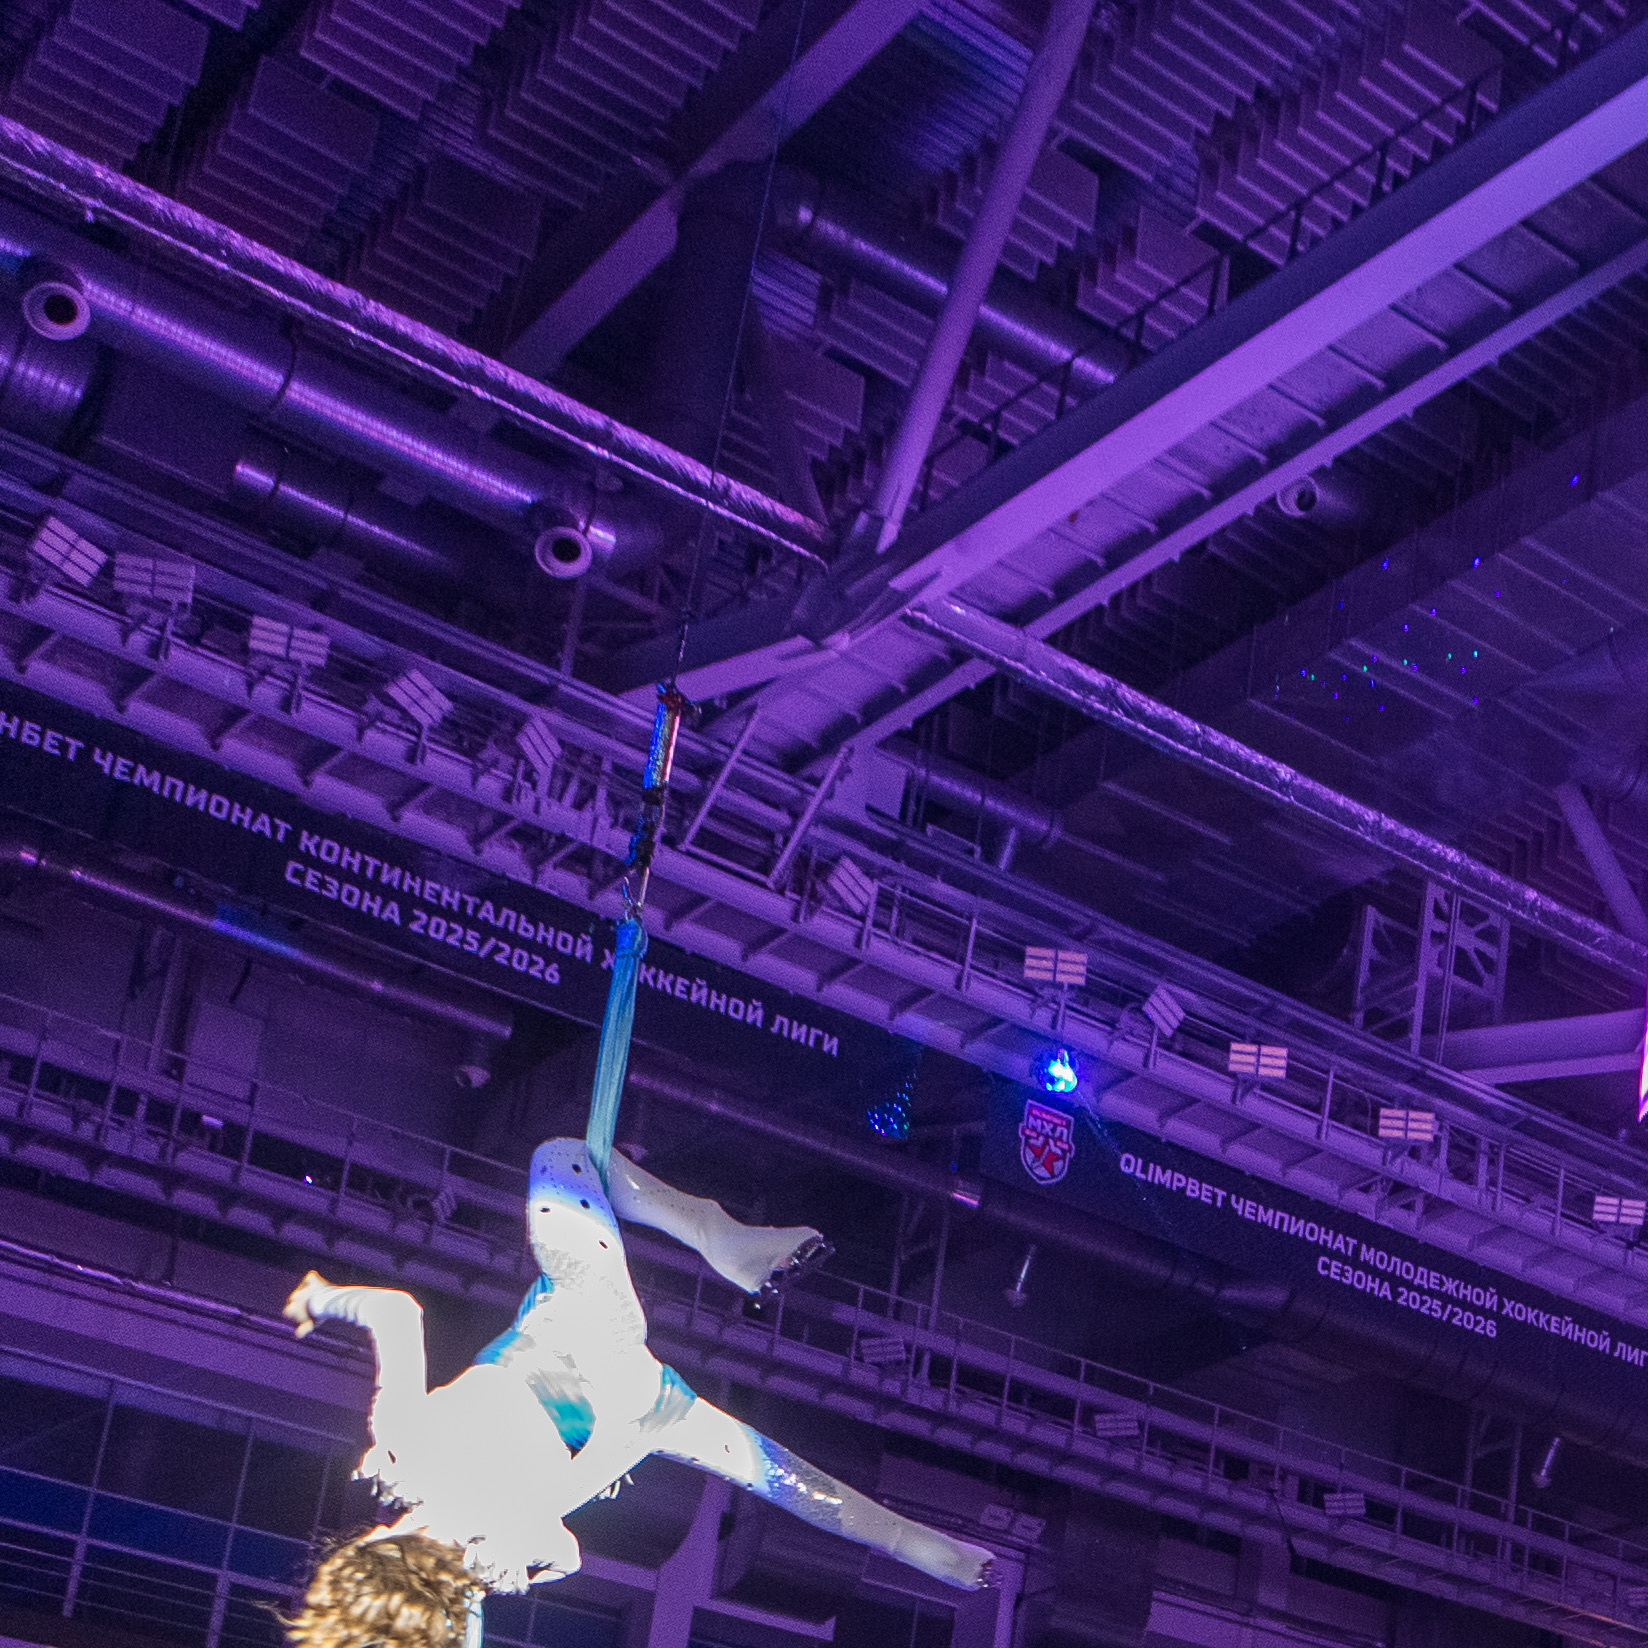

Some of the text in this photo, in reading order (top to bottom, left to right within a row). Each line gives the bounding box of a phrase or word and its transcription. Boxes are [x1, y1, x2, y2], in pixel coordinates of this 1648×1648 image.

[93, 745, 292, 843] ЧЕМПИОНАТ
[299, 829, 594, 965] КОНТИНЕНТАЛЬНОЙ
[600, 948, 764, 1029] ХККЕЙНОЙ
[769, 1014, 841, 1058] ЛИГИ
[284, 860, 561, 986] СЕЗОНА 2025/2026
[1026, 1114, 1070, 1144] МХЛ
[1119, 1153, 1227, 1208] OLIMPBET
[1230, 1193, 1358, 1256] ЧЕМПИОНАТ
[1360, 1246, 1498, 1313] МОЛОДЕЖНОЙ
[1501, 1297, 1611, 1355] ХОККЕЙНОЙ
[1316, 1255, 1497, 1339] СЕЗОНА 2025/2026
